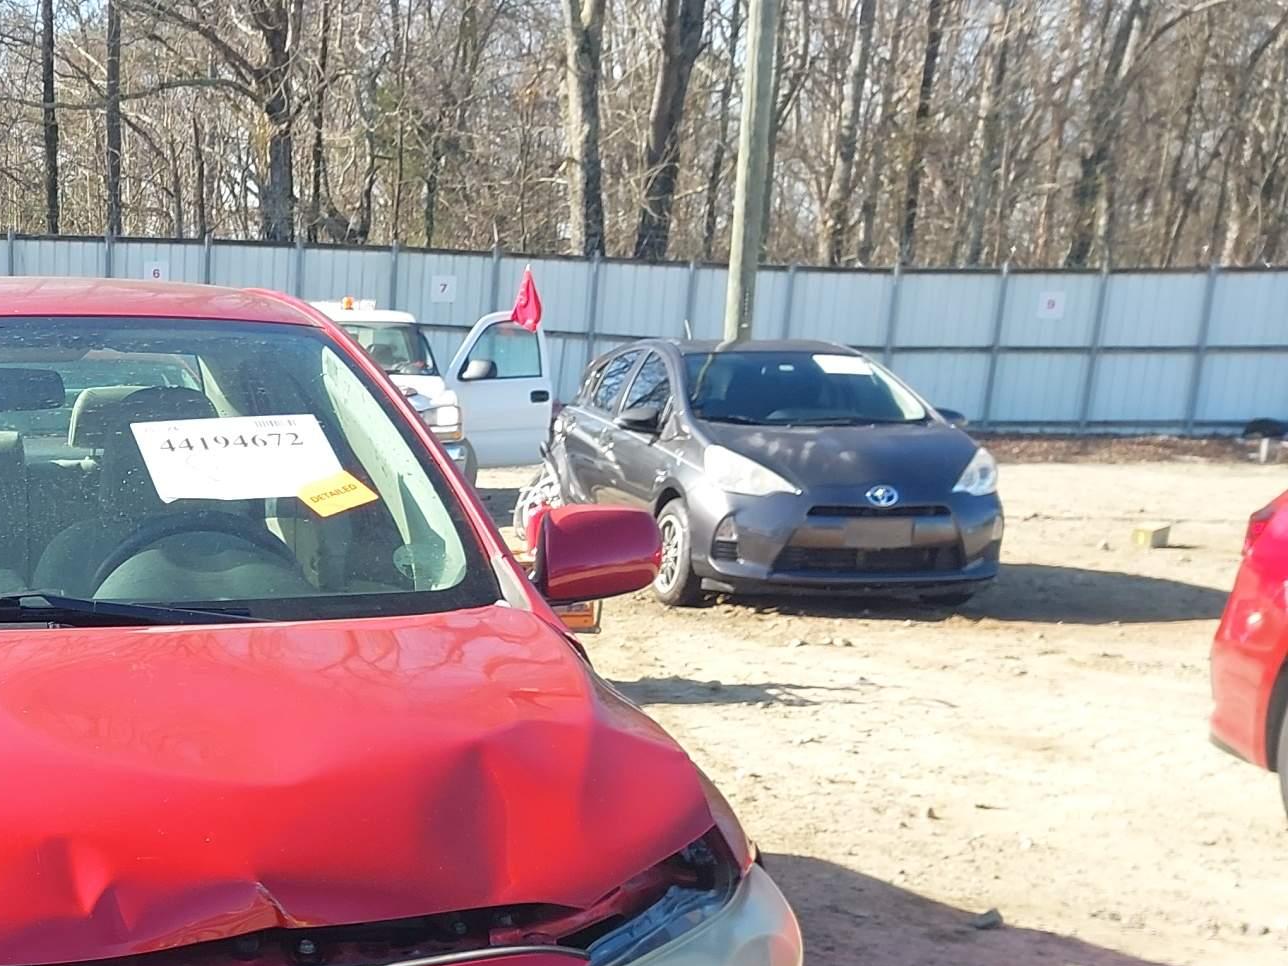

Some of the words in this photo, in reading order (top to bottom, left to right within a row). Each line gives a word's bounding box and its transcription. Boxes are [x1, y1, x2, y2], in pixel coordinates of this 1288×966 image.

[152, 268, 161, 279] 6
[439, 283, 448, 293] 7
[160, 432, 304, 452] 44194672
[310, 483, 358, 503] DETAILED
